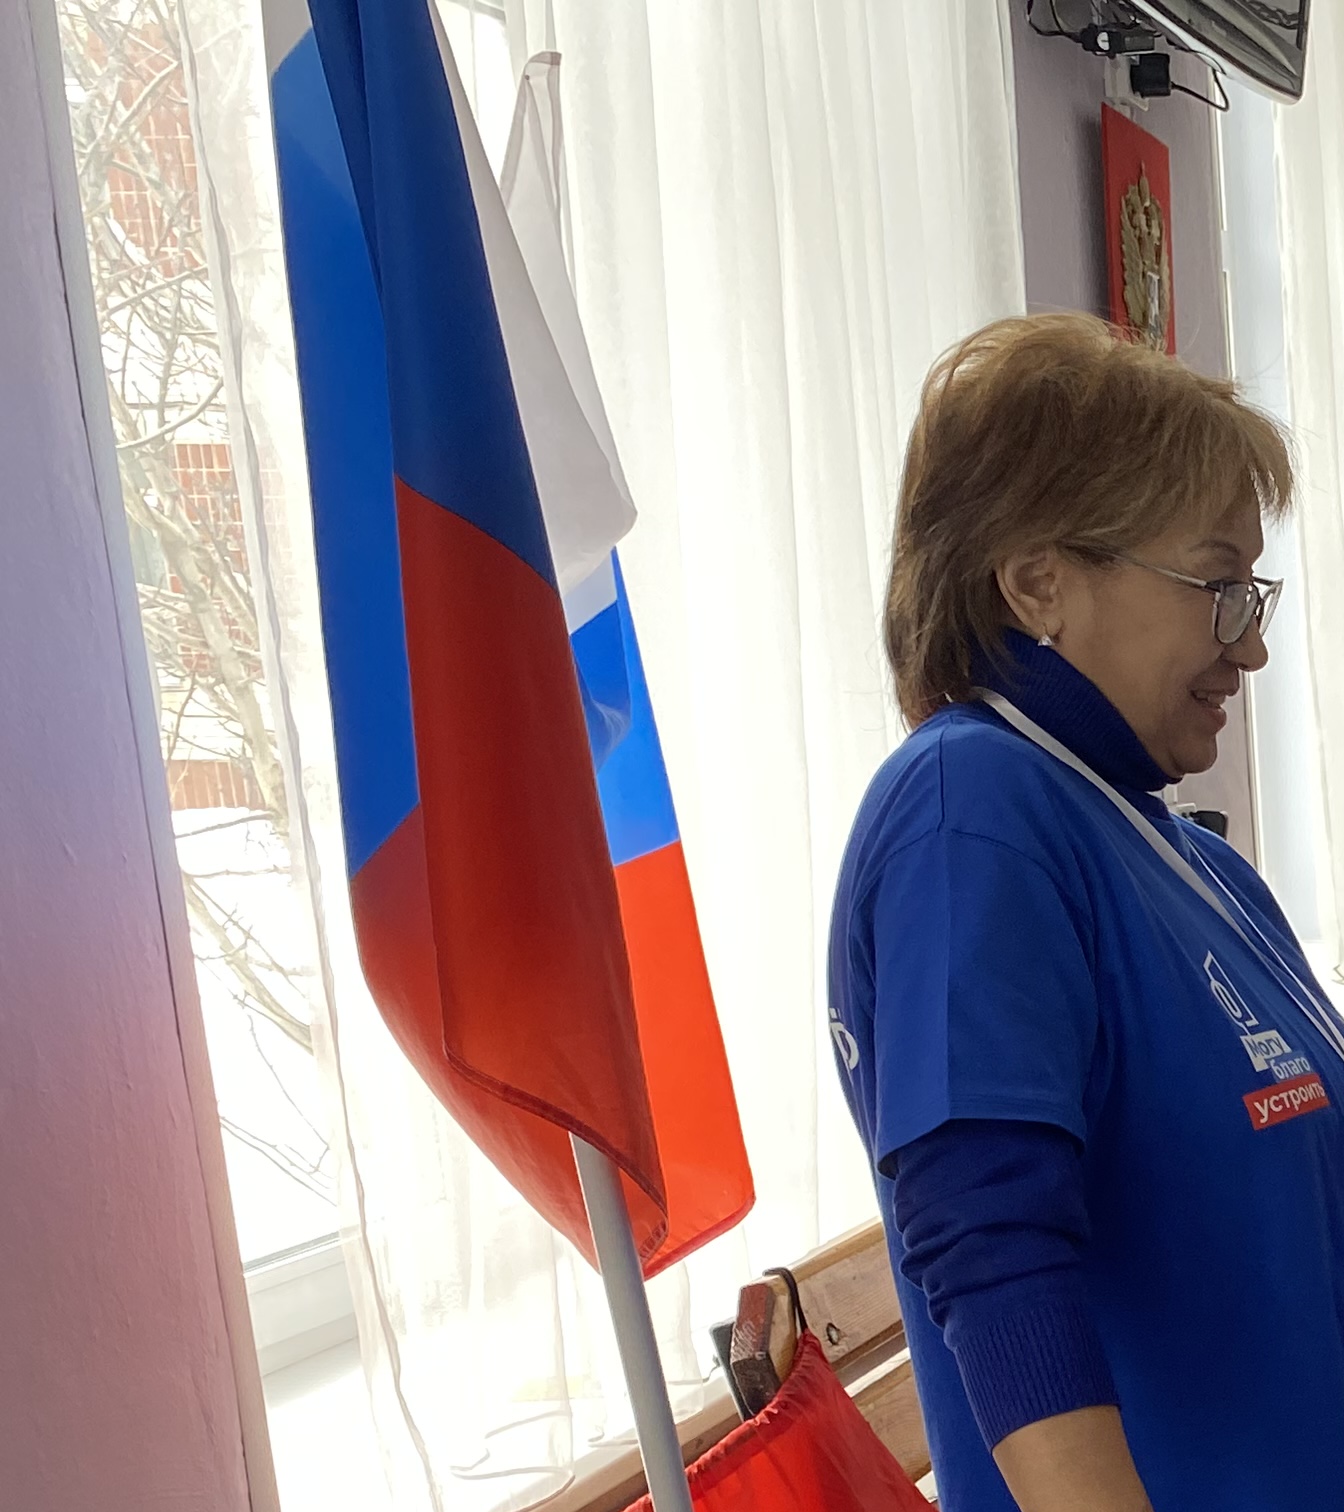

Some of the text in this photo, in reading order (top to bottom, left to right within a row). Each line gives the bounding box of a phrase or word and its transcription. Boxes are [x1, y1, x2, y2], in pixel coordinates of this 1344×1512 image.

[1246, 1037, 1286, 1058] Могу
[1270, 1057, 1311, 1079] благо
[1254, 1083, 1326, 1124] устроить
